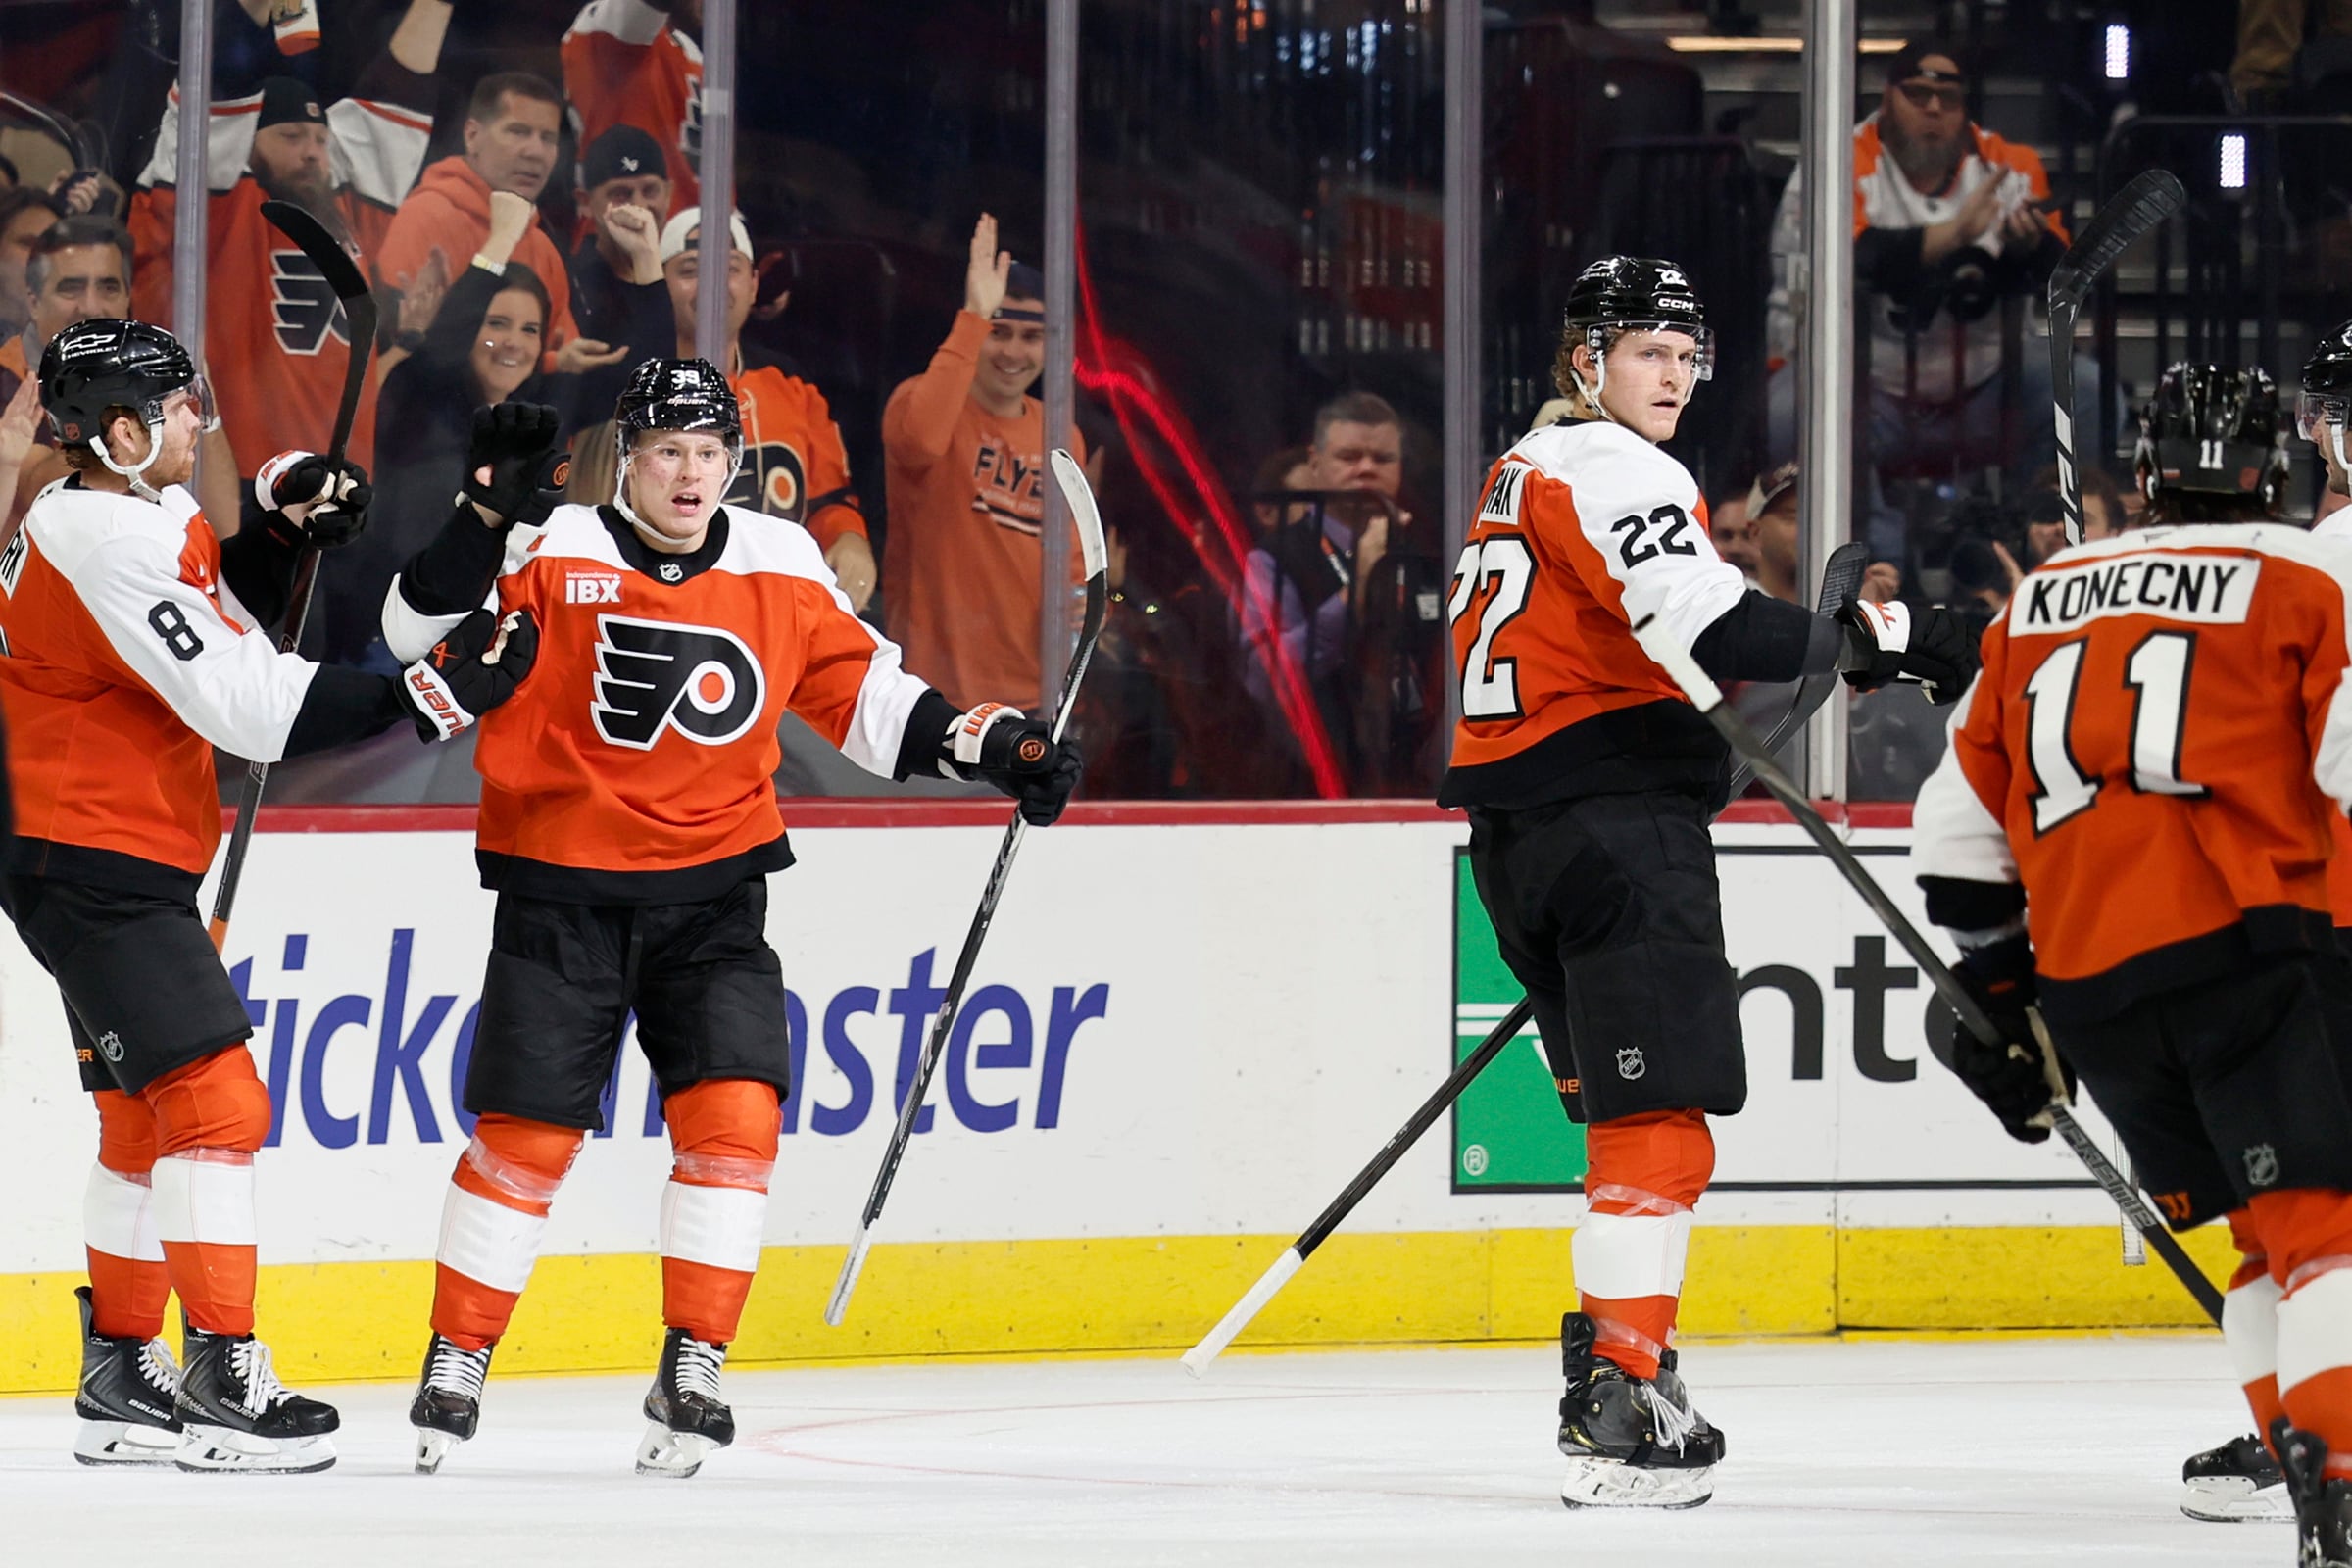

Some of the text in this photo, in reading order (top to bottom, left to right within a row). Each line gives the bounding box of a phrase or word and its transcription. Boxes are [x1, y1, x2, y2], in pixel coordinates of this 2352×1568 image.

[1657, 297, 1695, 311] CCM
[62, 346, 119, 361] HEVROLET
[670, 369, 701, 390] 39
[2199, 439, 2224, 469] 11
[1609, 503, 1698, 570] 22
[565, 579, 621, 604] IBX
[2027, 561, 2240, 625] KONECNY
[148, 600, 204, 661] 8
[2022, 627, 2213, 841] 11
